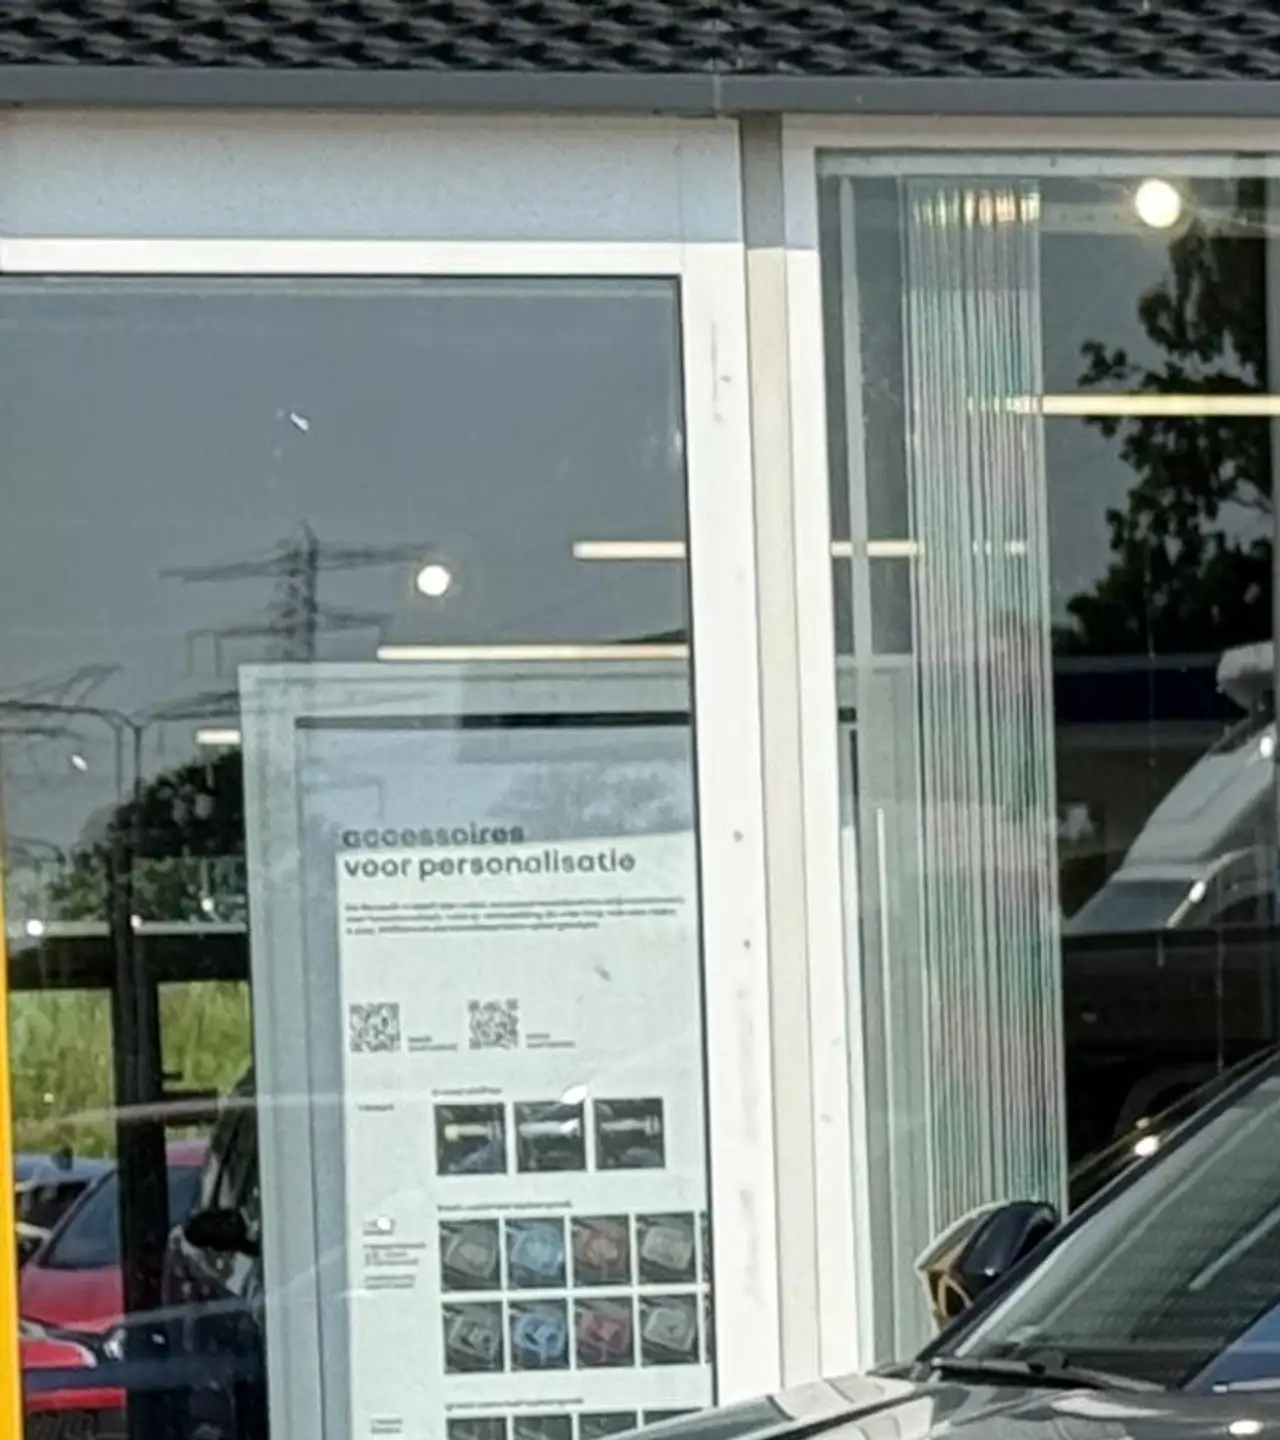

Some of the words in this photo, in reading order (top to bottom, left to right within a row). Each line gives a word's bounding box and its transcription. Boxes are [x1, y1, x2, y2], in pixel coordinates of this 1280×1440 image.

[342, 822, 525, 848] accessoires
[344, 856, 412, 878] voor
[419, 848, 636, 881] personalisatie
